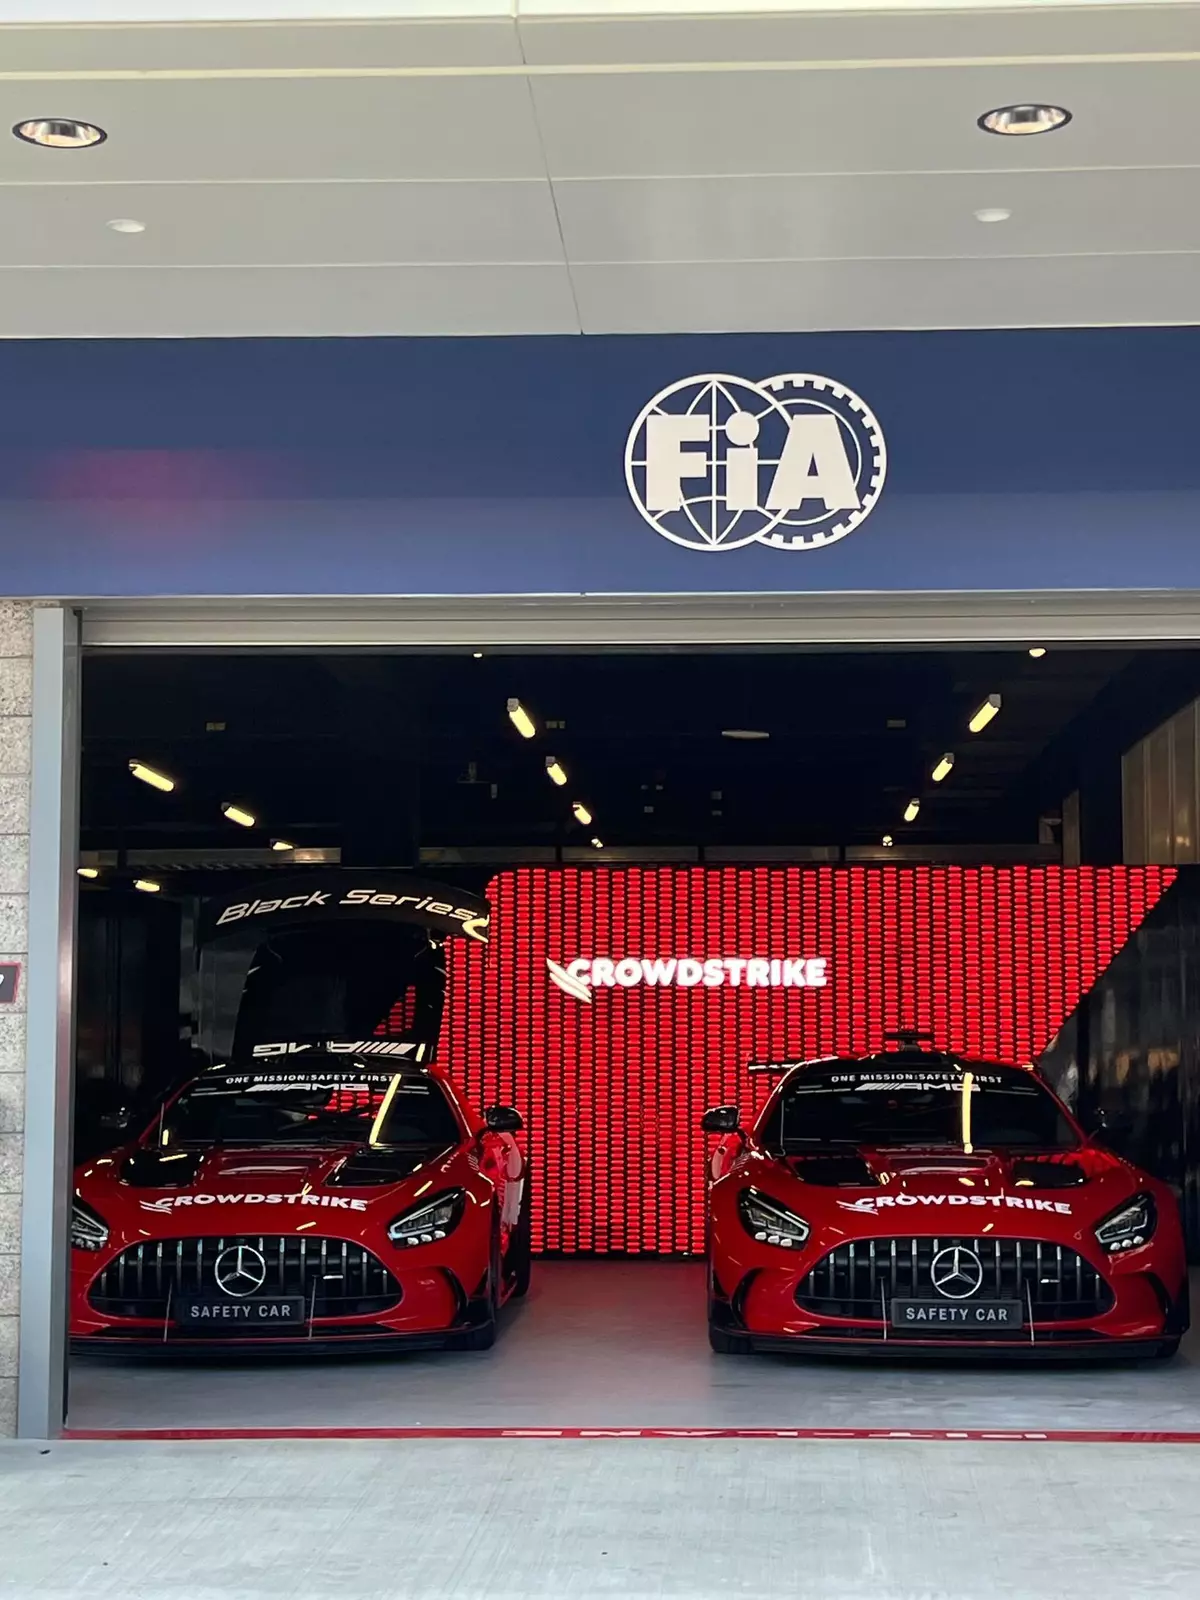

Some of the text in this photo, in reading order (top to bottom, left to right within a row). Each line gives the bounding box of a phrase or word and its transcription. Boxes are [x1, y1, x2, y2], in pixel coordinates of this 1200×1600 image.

[216, 889, 477, 926] Black Series
[566, 958, 827, 987] CROWDSTRIKE
[225, 1076, 249, 1085] ONE
[831, 1074, 856, 1083] ONE
[154, 1193, 369, 1212] CROWDSTRIKE
[855, 1194, 1073, 1215] CROWDSTRIKE
[190, 1304, 291, 1318] SAFETY CAR
[906, 1307, 1008, 1321] SAFETY CAR
